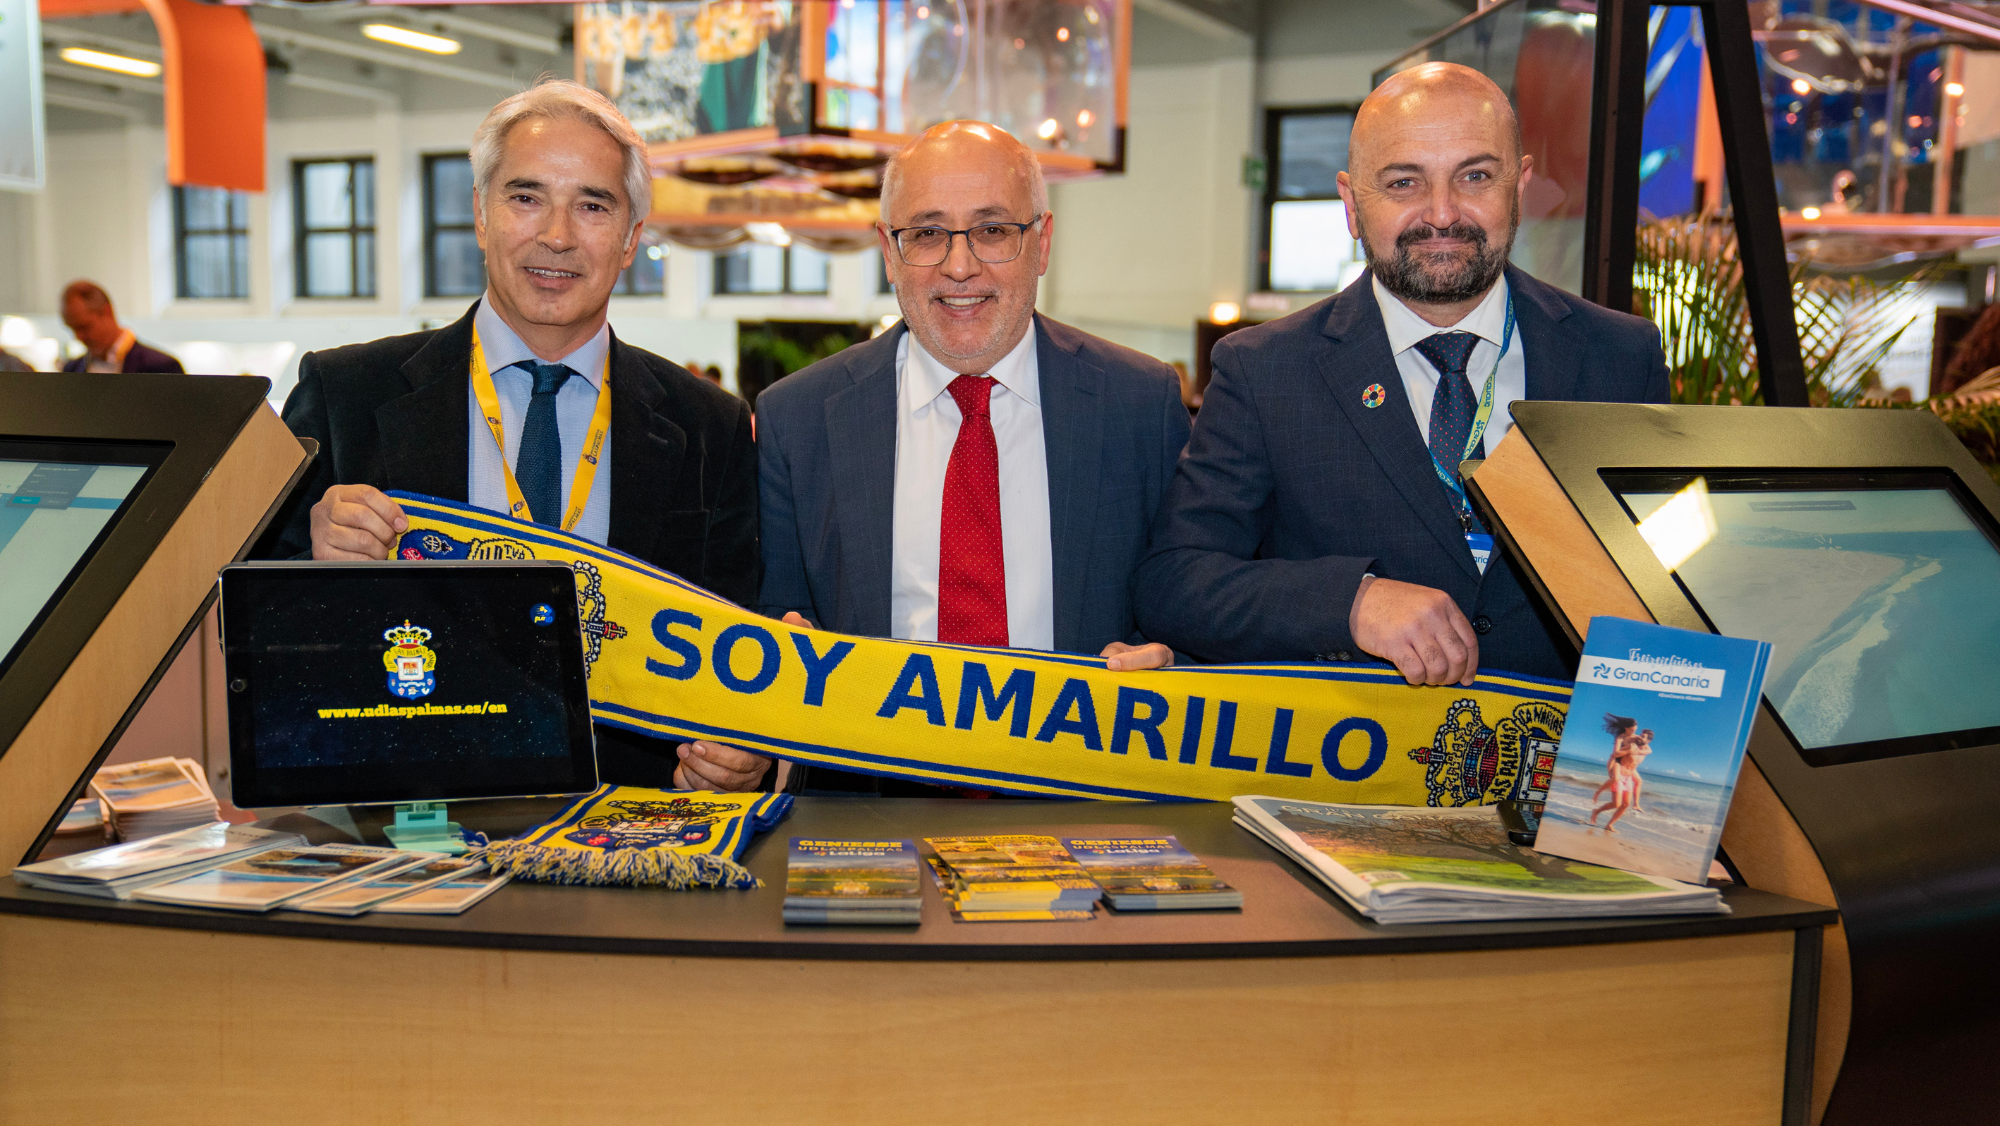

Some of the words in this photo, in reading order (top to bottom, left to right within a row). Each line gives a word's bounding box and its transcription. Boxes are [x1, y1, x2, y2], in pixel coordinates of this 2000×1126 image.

[1613, 667, 1710, 689] GranCanaria
[645, 607, 857, 707] SOY
[876, 652, 1388, 783] AMARILLO
[317, 701, 508, 719] www.udlaspalmas.es/en
[1500, 723, 1519, 777] PALMAS
[799, 840, 902, 848] GENIESSE
